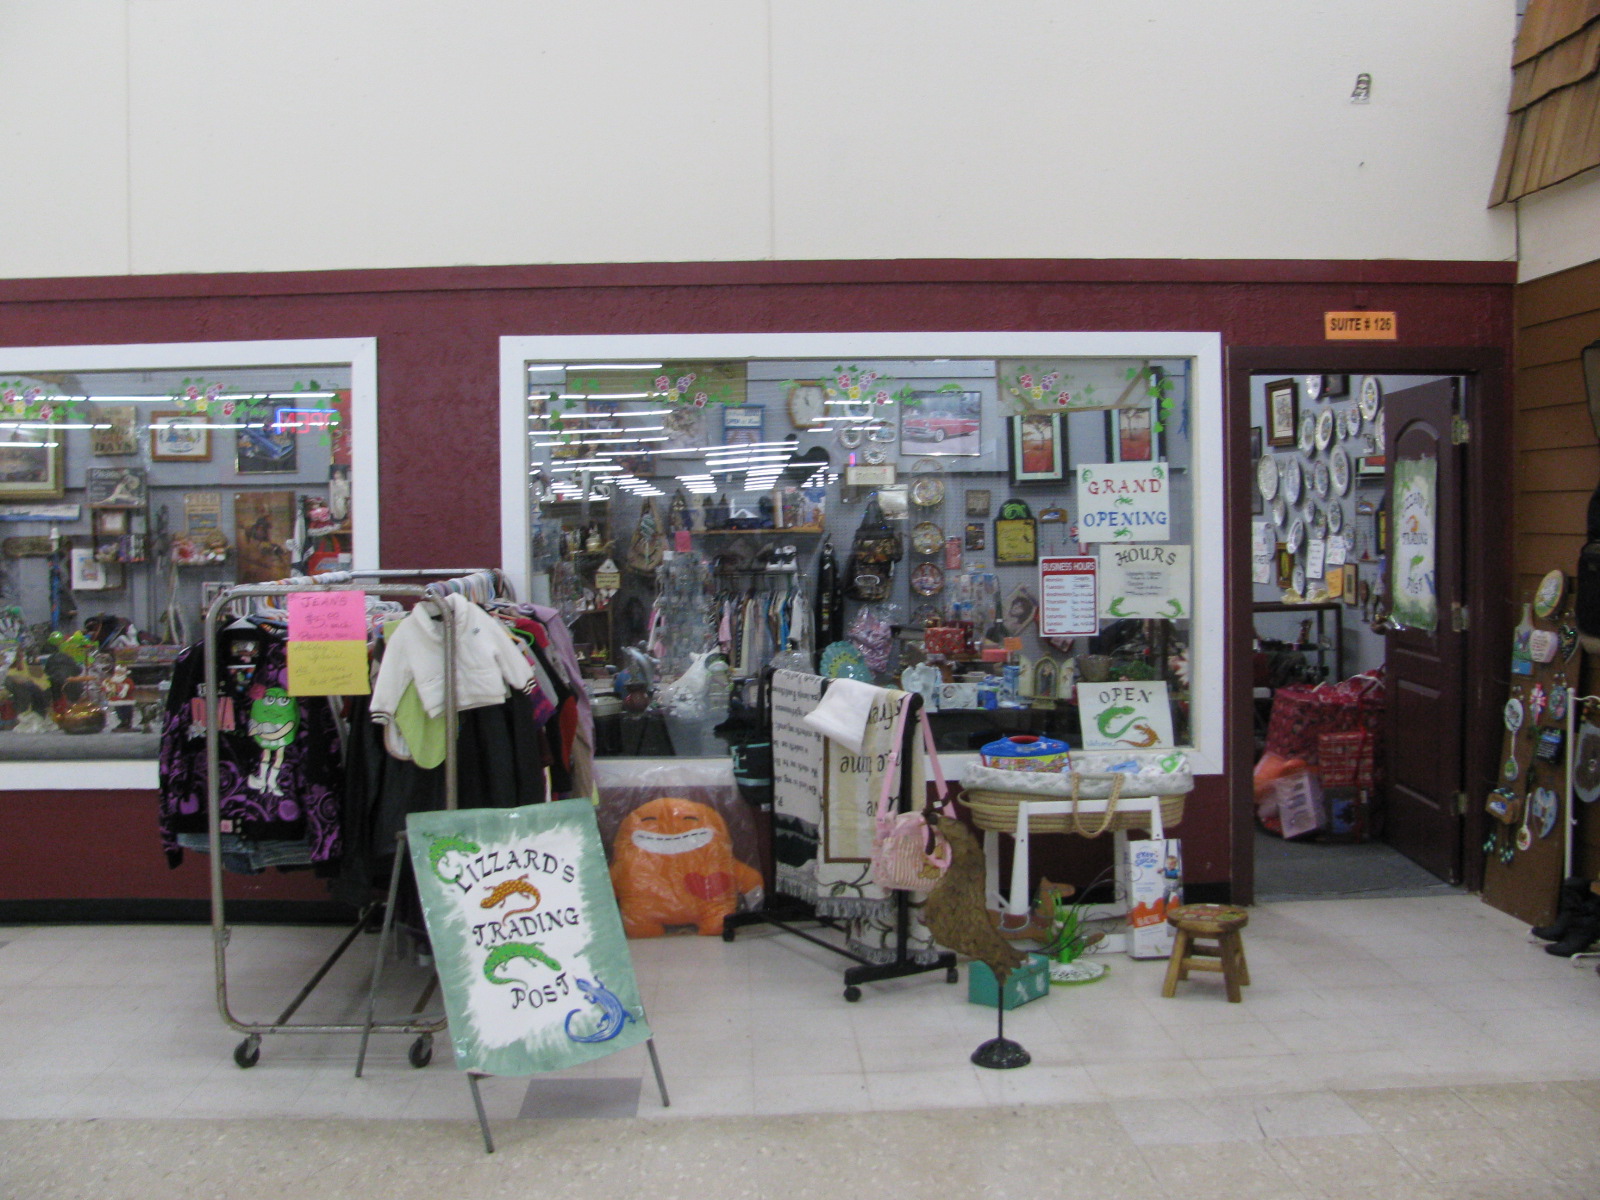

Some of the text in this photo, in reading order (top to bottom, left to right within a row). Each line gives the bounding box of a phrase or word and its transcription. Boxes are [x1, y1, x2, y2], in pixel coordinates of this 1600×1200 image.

[1330, 317, 1362, 331] SUITE
[1363, 317, 1371, 331] #
[1087, 478, 1162, 495] GRAND
[1083, 511, 1168, 527] OPENING
[1114, 547, 1177, 567] HOURS
[1042, 561, 1096, 571] BUSINESS HOURS
[1099, 687, 1153, 704] OPEN
[455, 848, 576, 894] LIZZARD'S
[471, 906, 580, 946] TRADING
[510, 971, 570, 1010] POST
